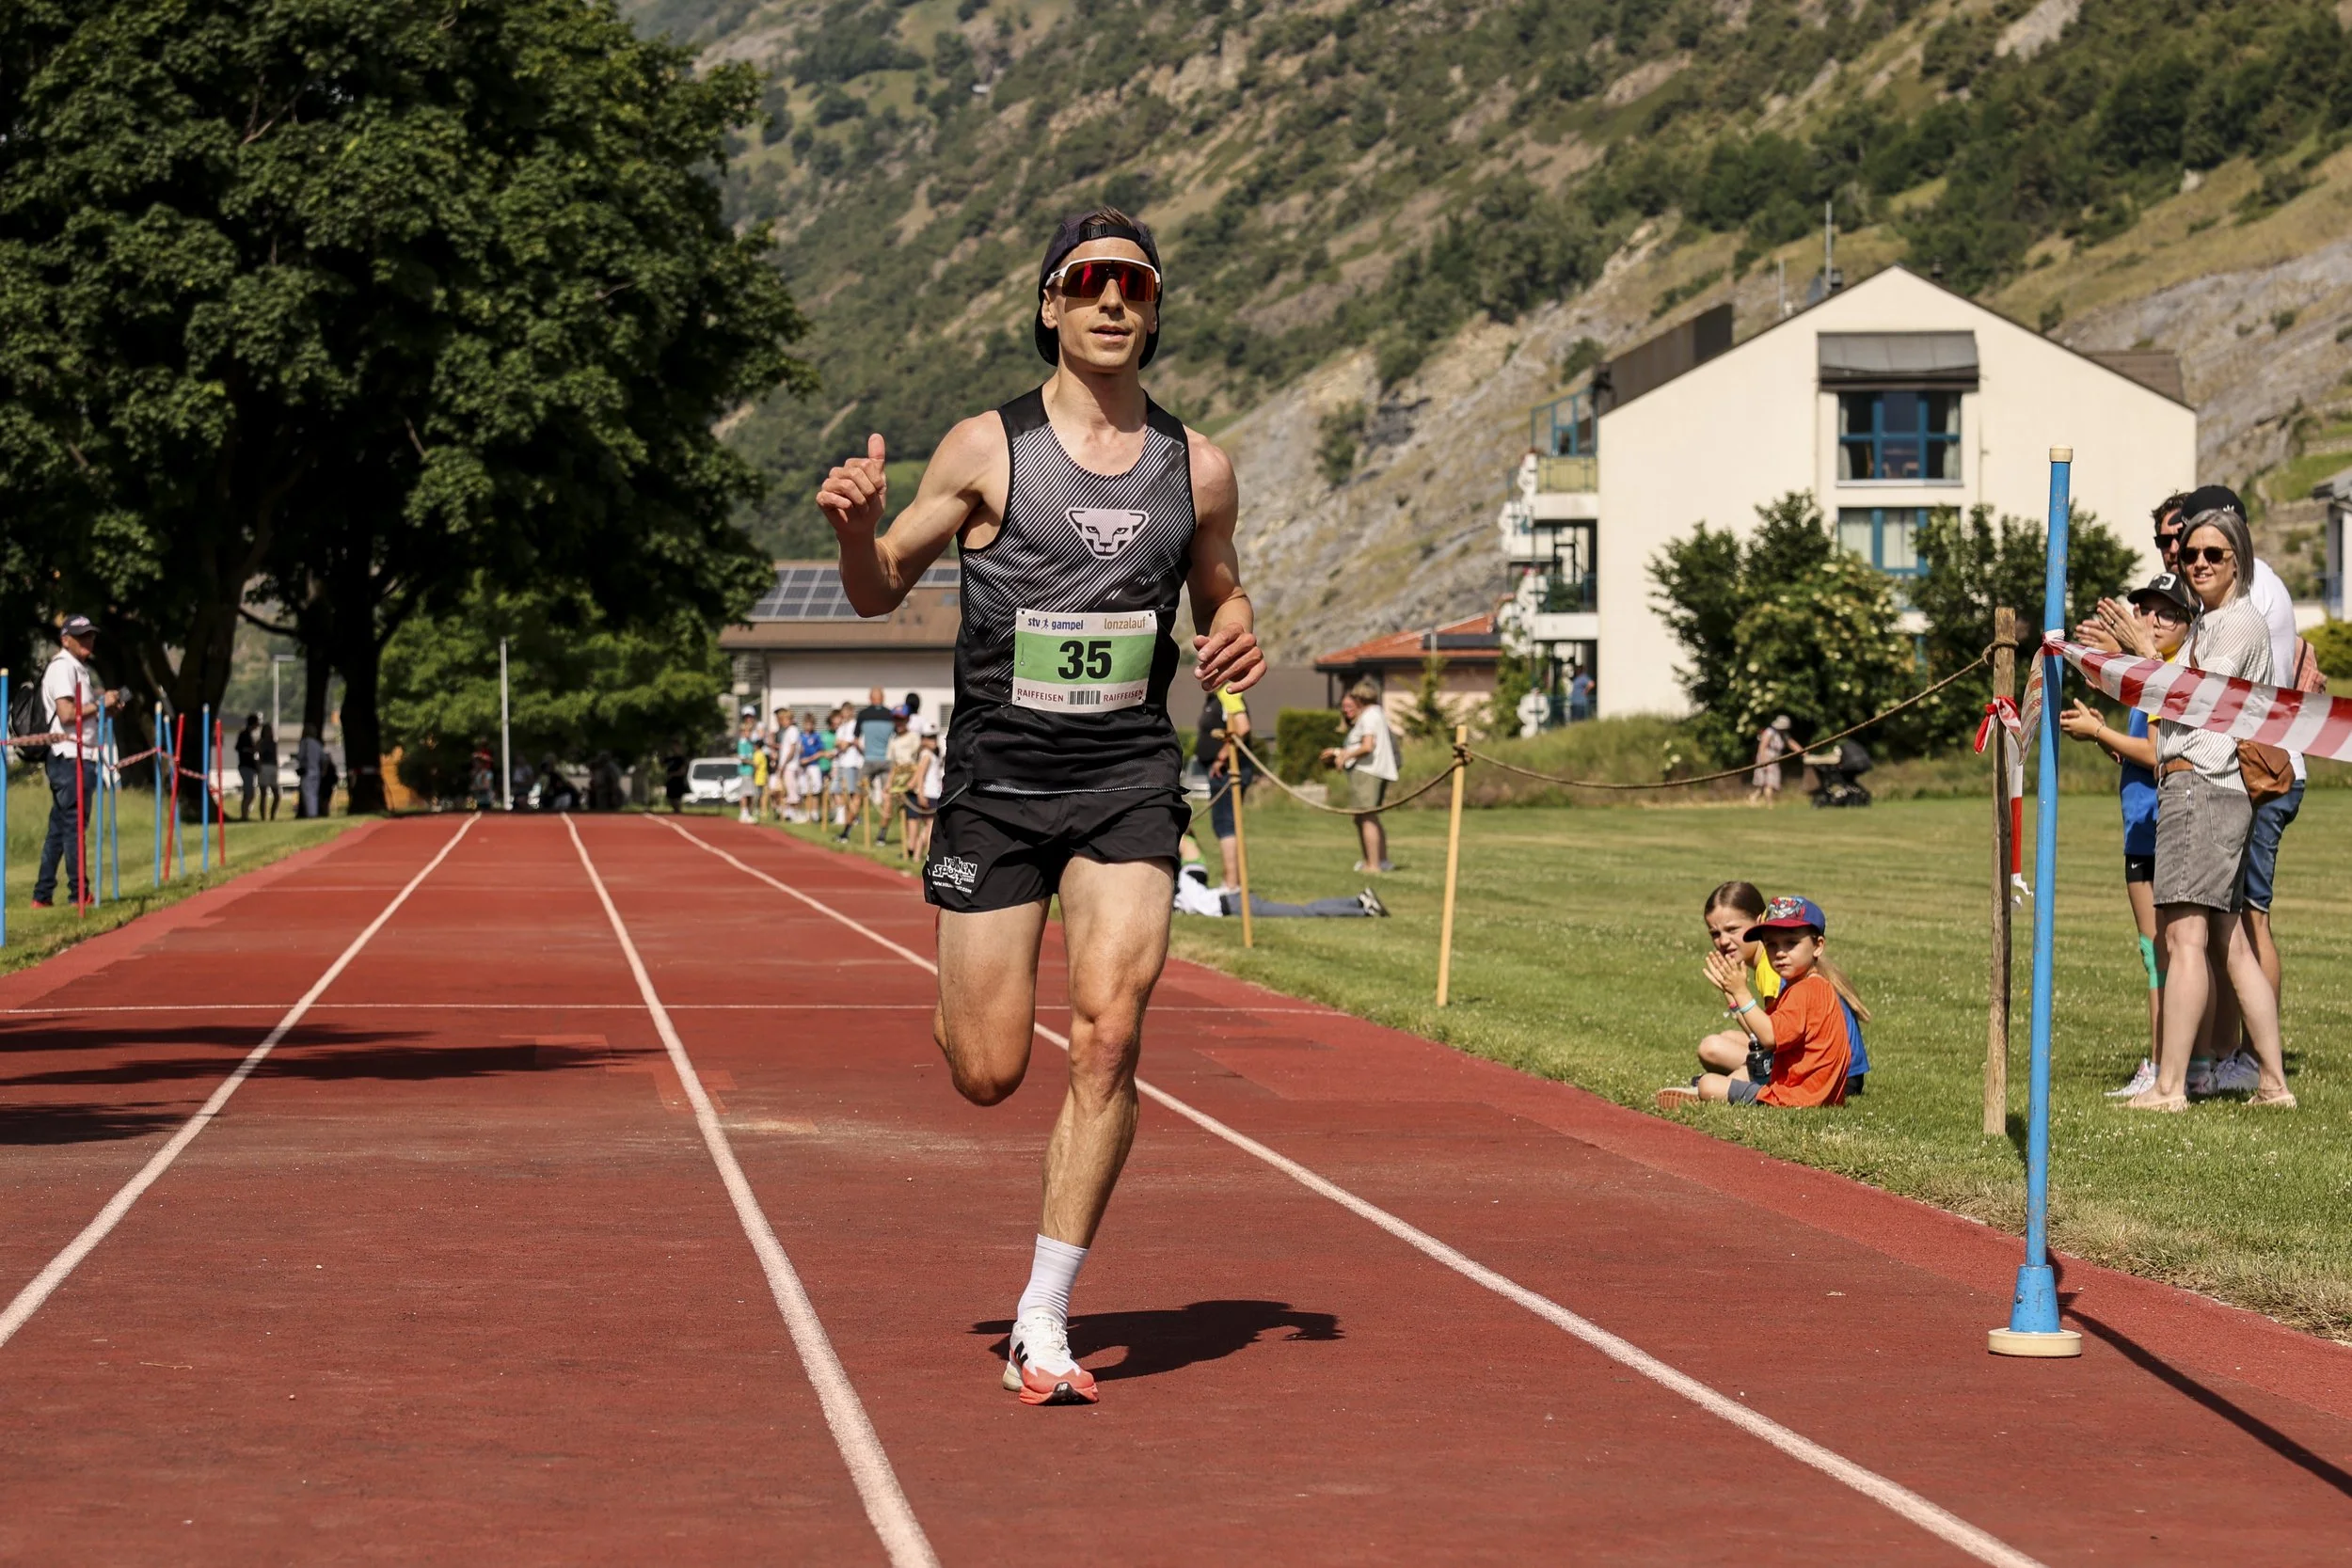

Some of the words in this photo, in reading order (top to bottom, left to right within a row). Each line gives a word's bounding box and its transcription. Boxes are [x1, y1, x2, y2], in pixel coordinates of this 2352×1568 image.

[1027, 617, 1041, 627] stv
[1051, 619, 1084, 631] gampel
[1104, 616, 1146, 630] lonzalauf
[1057, 640, 1112, 680] 35
[1017, 688, 1064, 703] RAIFFEISEN
[1103, 689, 1144, 703] RAIFFEISEN
